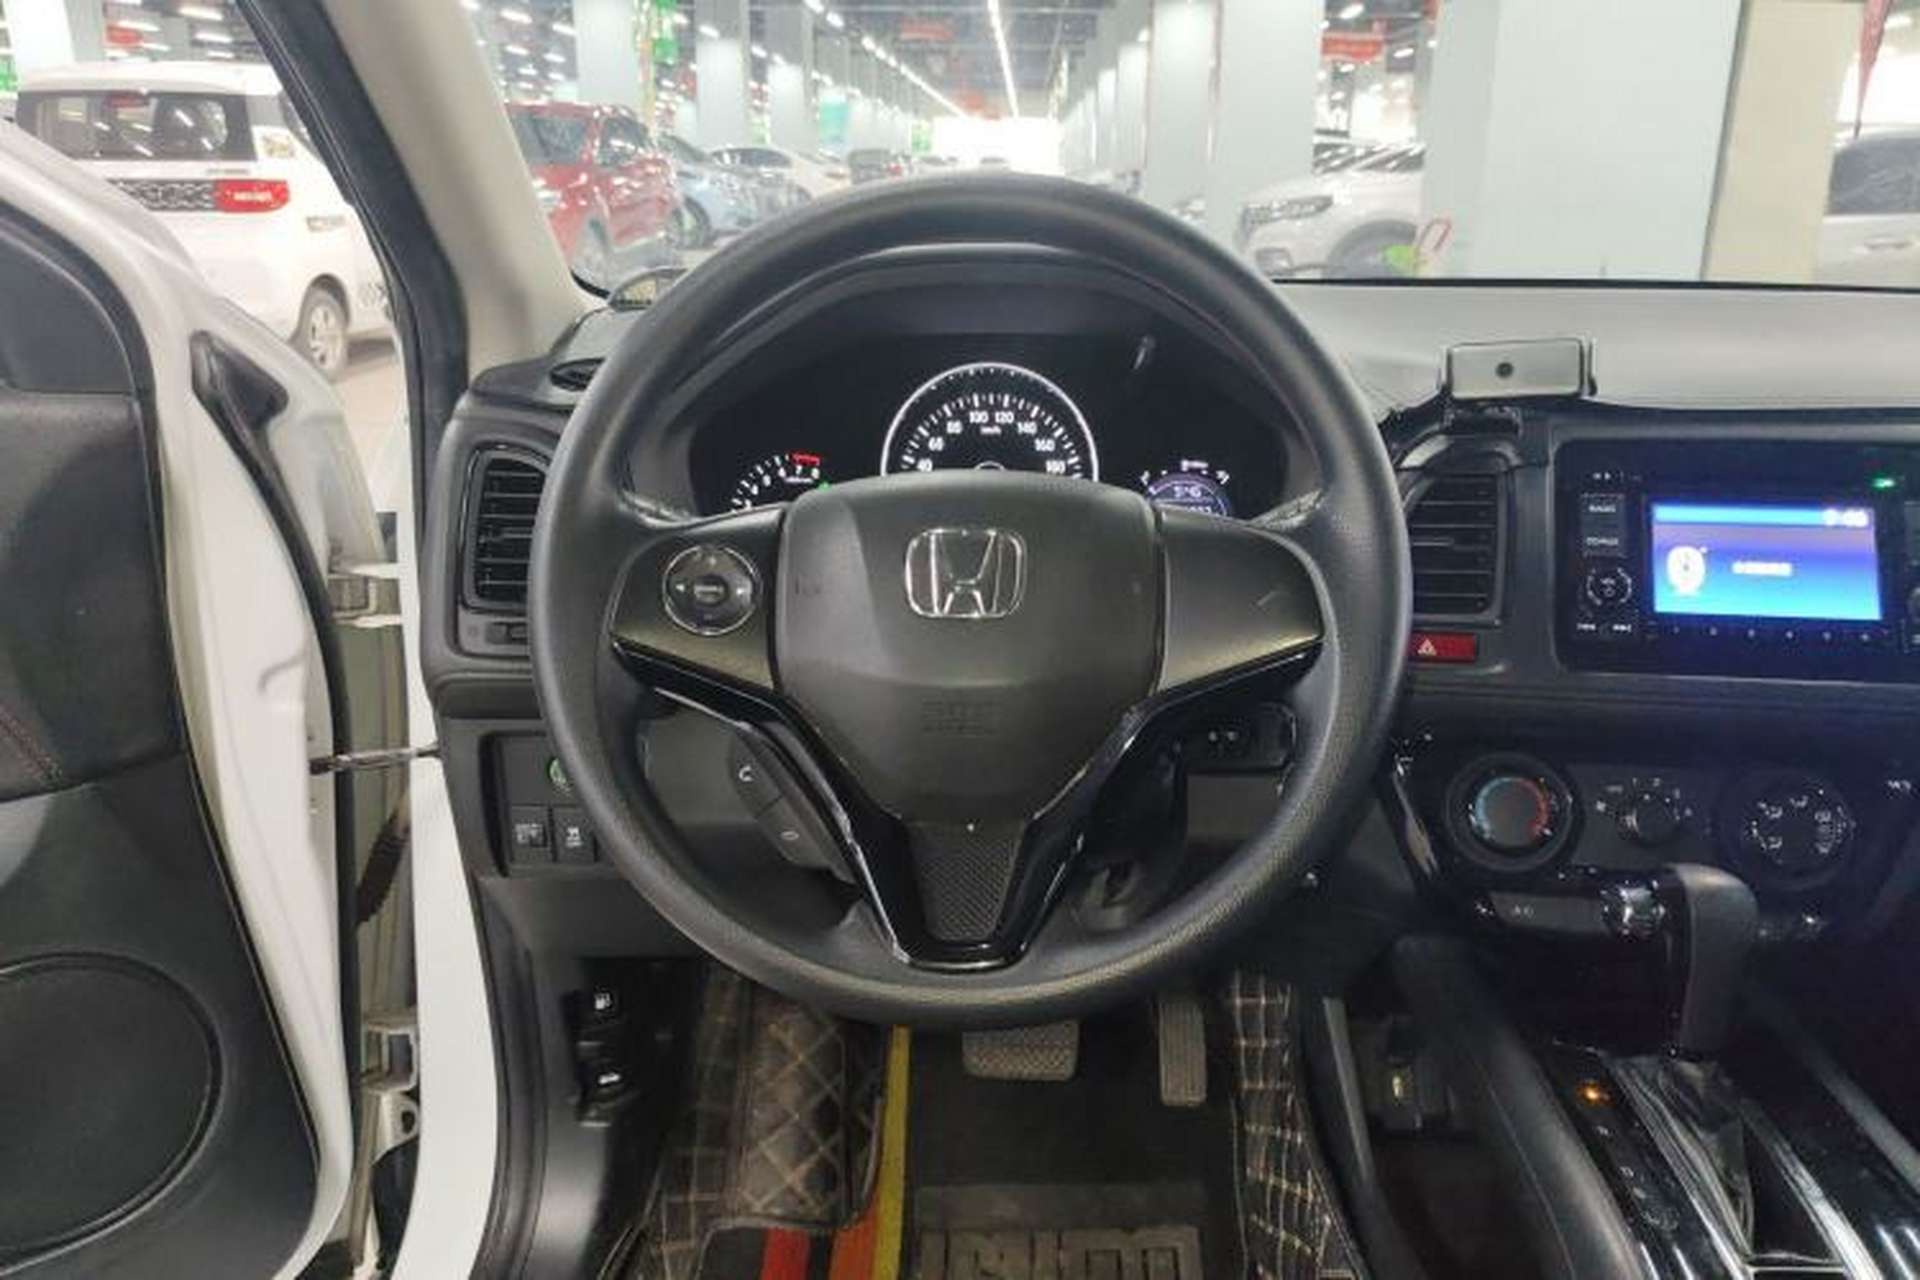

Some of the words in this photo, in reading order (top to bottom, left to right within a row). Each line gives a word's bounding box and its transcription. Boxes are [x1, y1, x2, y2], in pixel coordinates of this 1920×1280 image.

[969, 411, 989, 423] 100
[995, 411, 1014, 423] 120
[1017, 422, 1037, 434] 140
[1034, 438, 1055, 451] 160
